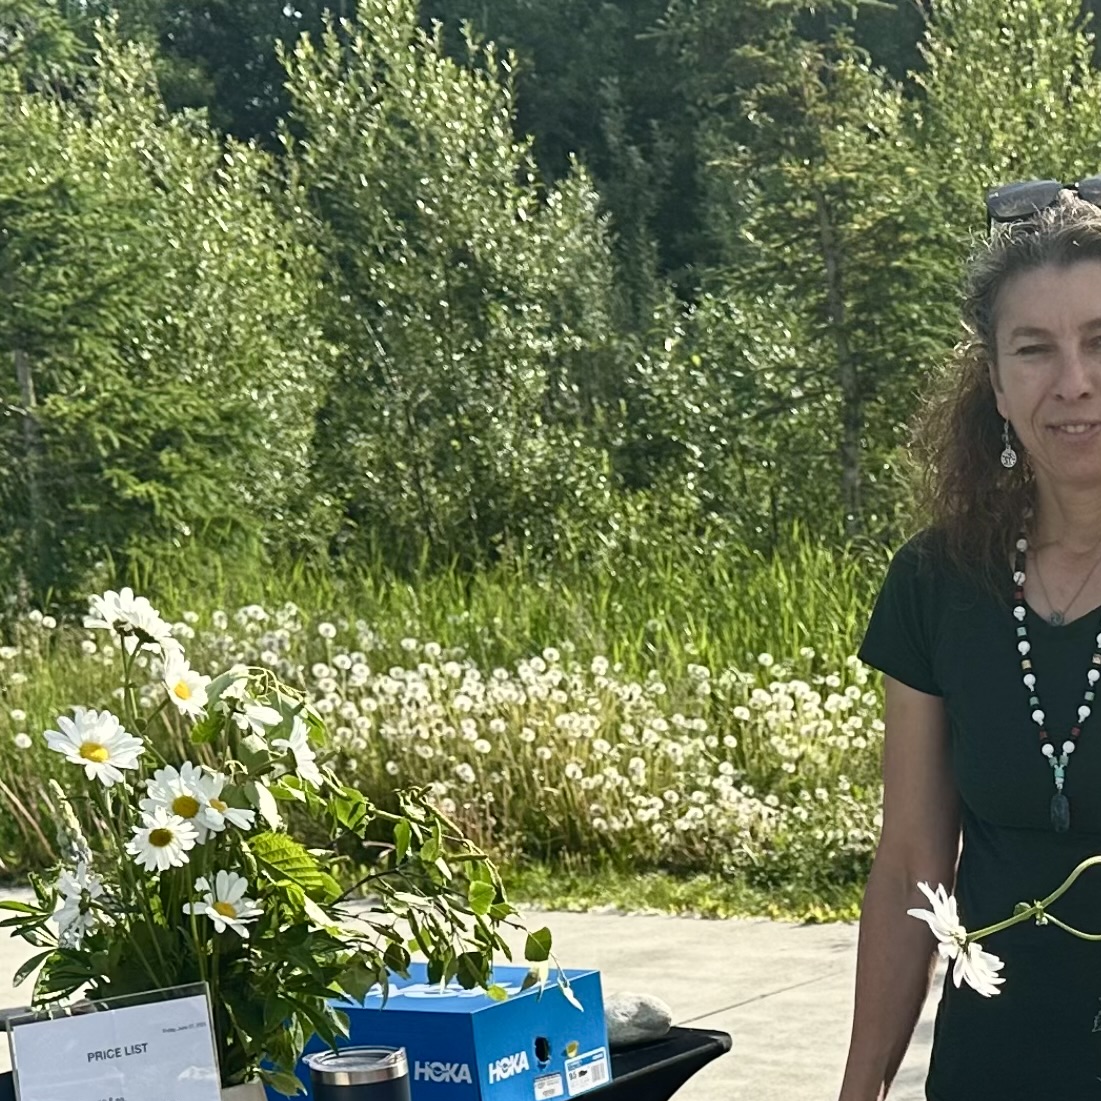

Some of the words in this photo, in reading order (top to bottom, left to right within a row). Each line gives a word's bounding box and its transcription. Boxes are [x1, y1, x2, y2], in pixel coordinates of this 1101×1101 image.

[87, 1047, 122, 1063] PRICE
[124, 1043, 148, 1057] LIST
[414, 1061, 472, 1085] HOKA
[489, 1051, 529, 1085] HOKA
